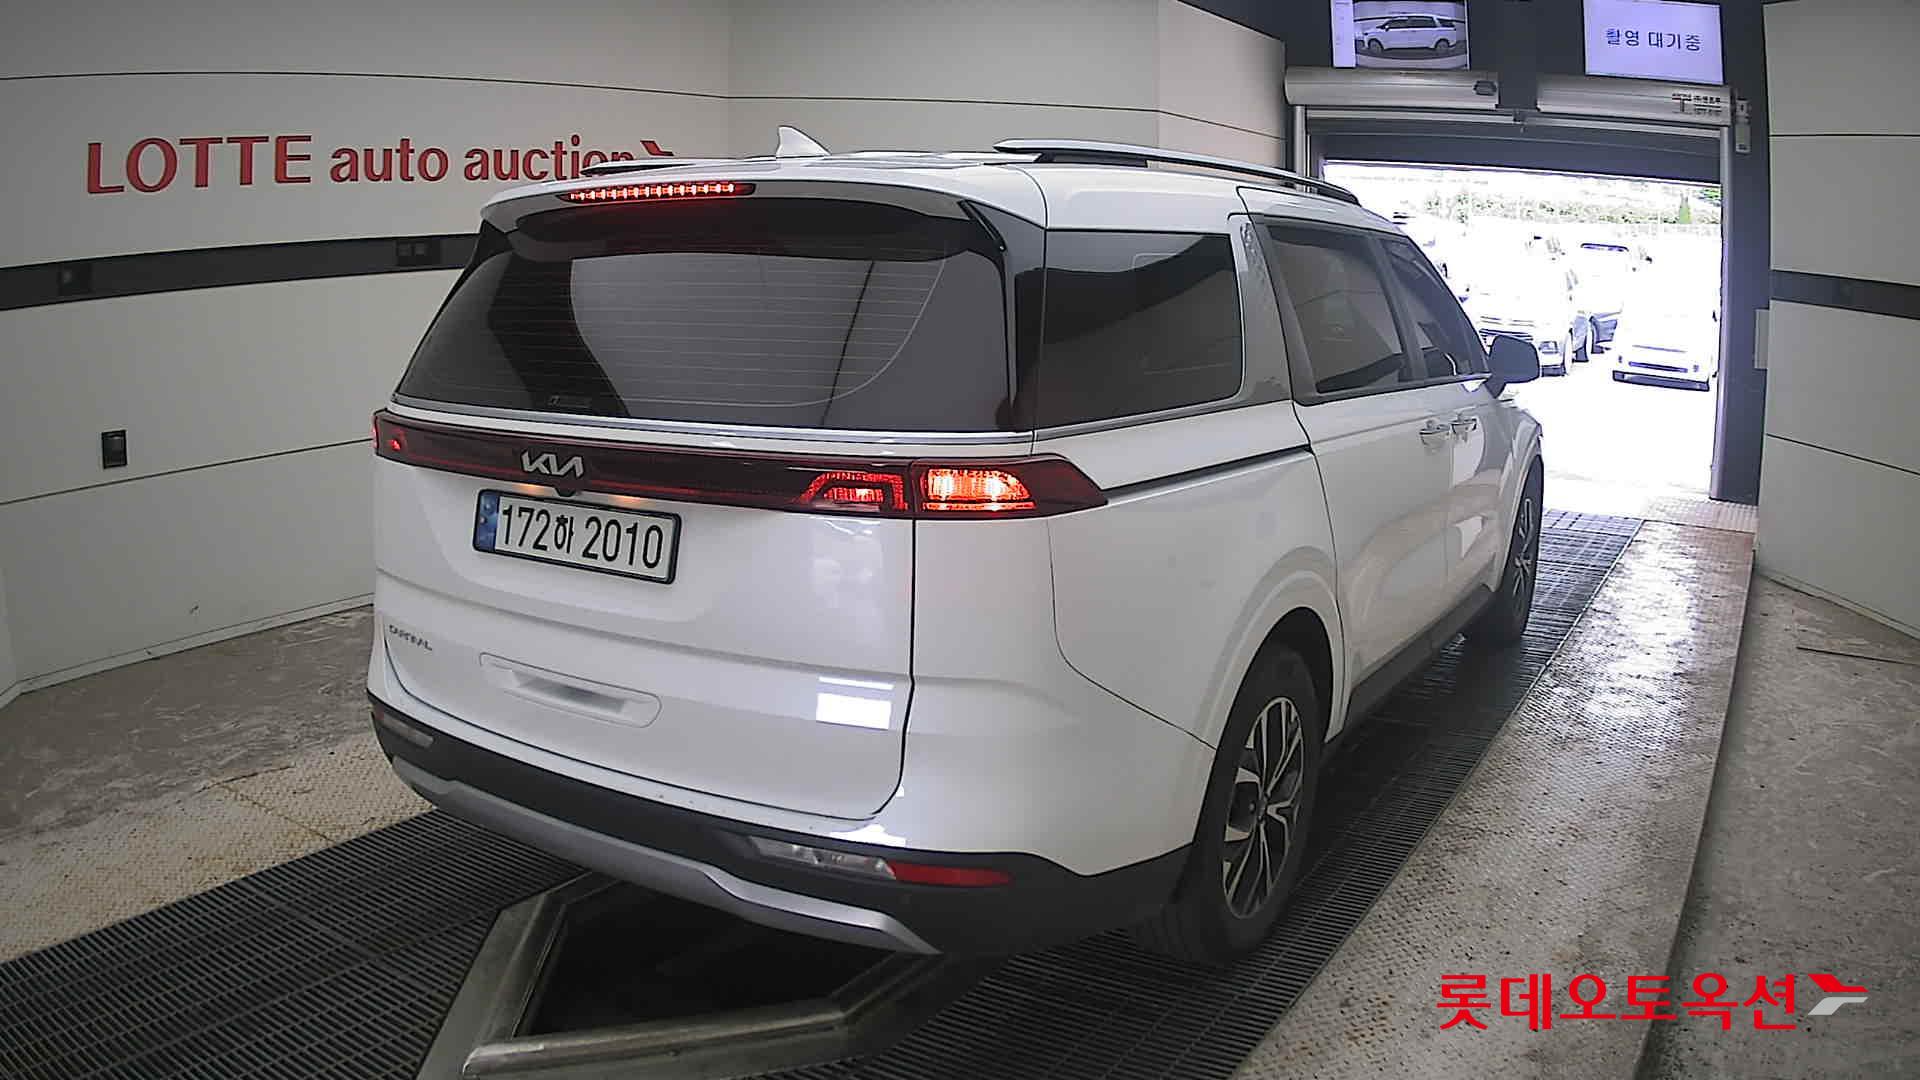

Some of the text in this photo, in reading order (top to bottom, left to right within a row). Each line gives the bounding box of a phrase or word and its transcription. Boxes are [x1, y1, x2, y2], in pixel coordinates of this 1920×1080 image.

[1648, 31, 1701, 52] 대기중
[88, 135, 312, 194] LOTTE
[330, 138, 449, 183] auto
[502, 504, 664, 570] 172하 2010
